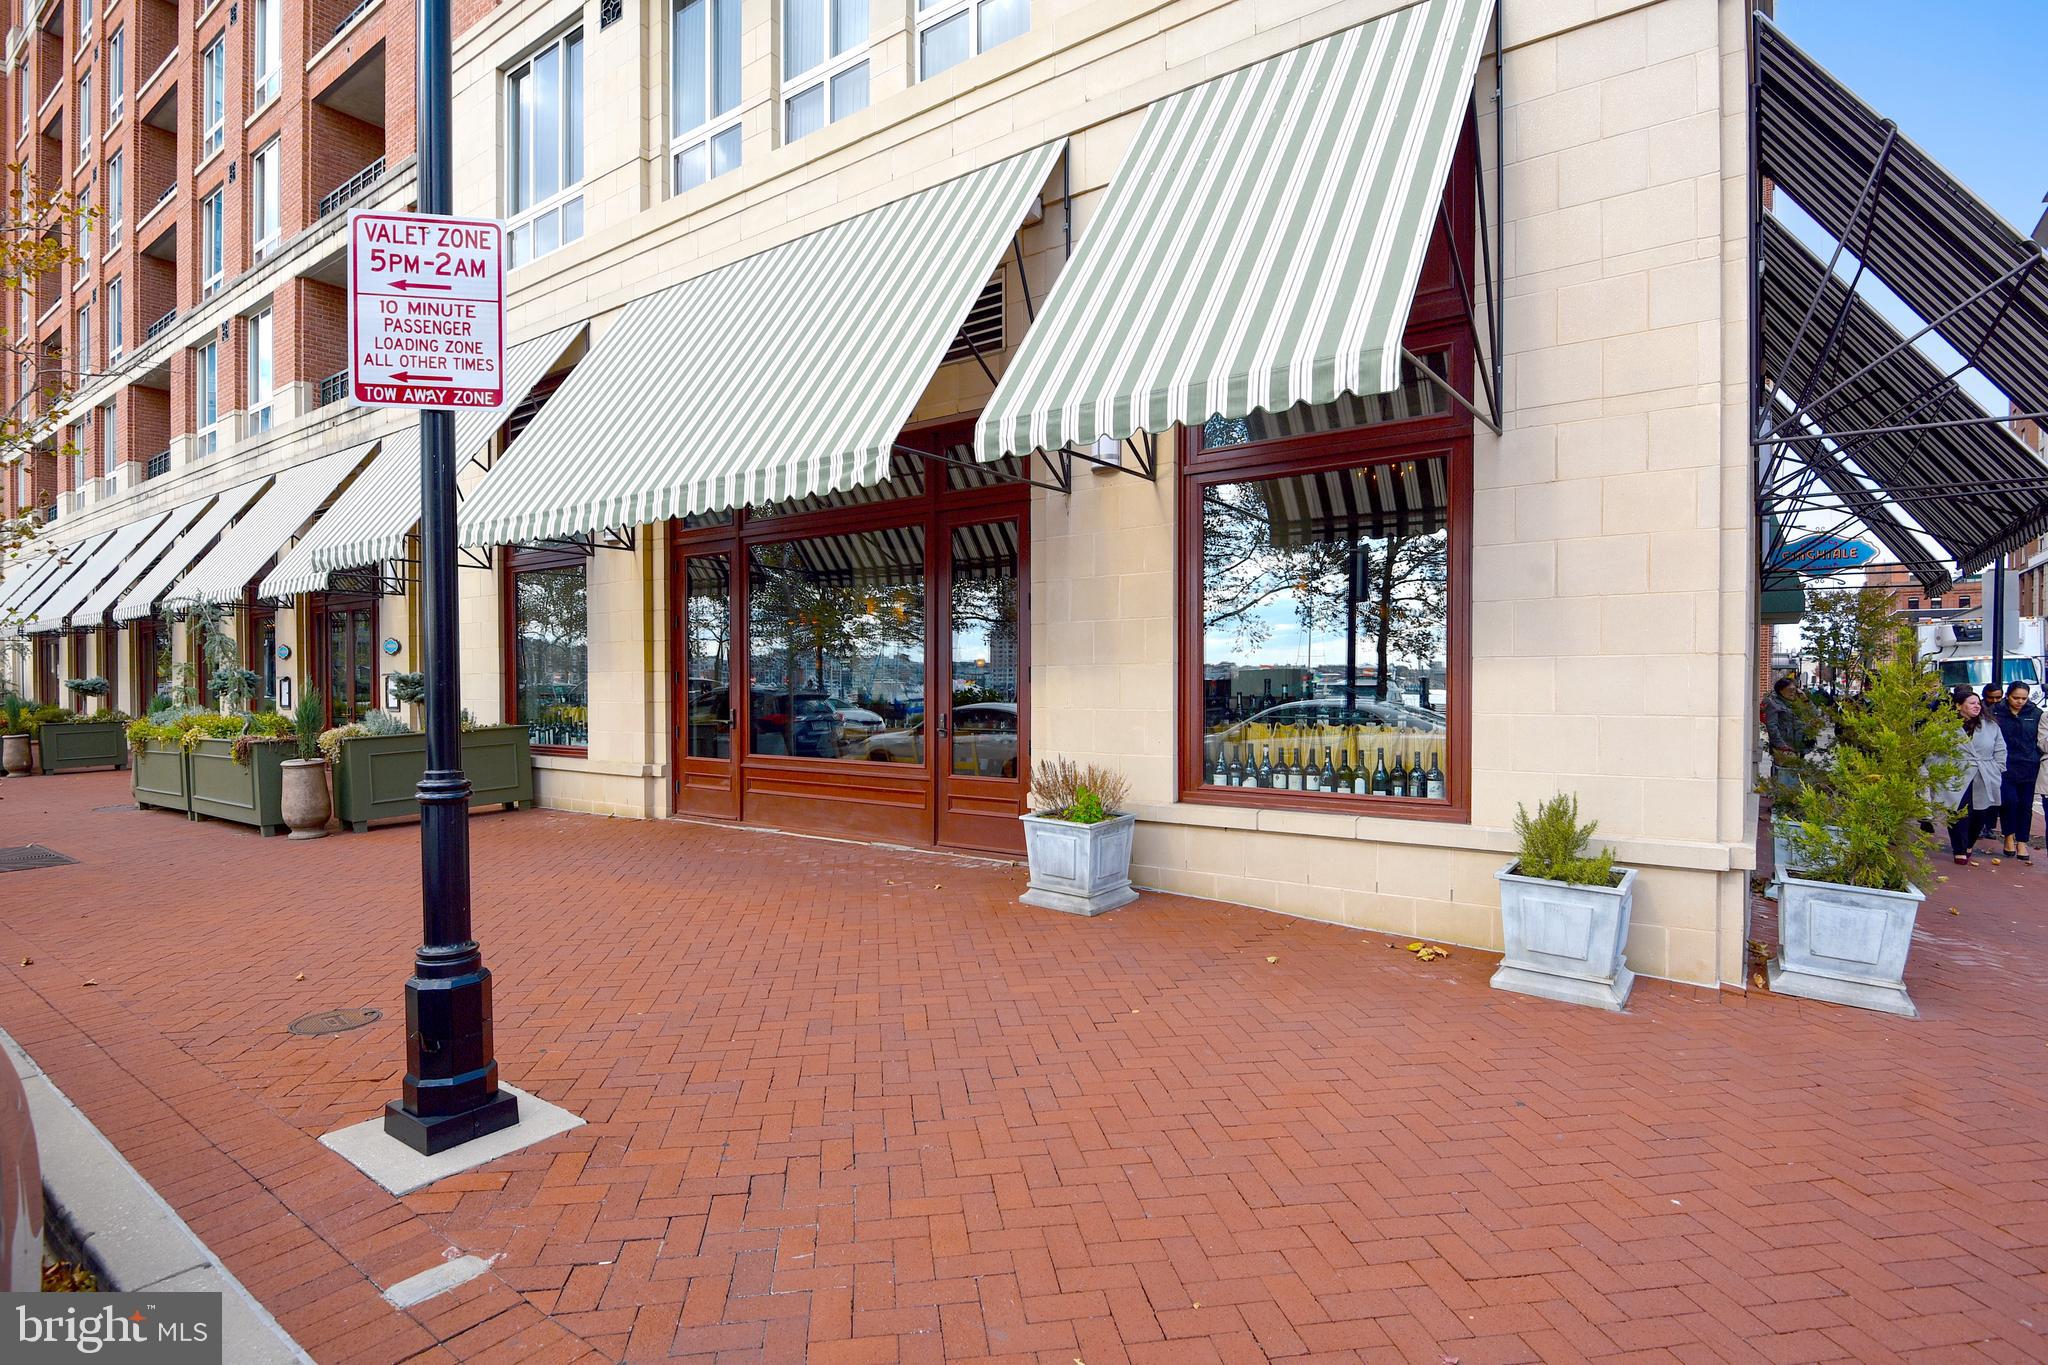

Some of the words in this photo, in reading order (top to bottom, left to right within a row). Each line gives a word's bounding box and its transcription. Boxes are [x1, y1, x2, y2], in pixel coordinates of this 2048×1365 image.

[364, 222, 430, 245] VALET
[437, 227, 492, 250] ZONE
[370, 248, 486, 279] 5PM-2AM
[379, 299, 399, 315] 10
[408, 301, 477, 319] MINUTE
[384, 317, 471, 337] PASSENGER
[374, 336, 439, 353] LOADING
[445, 340, 484, 355] ZONE
[363, 352, 394, 367] ALL
[399, 354, 447, 370] OTHER
[453, 356, 495, 372] TIMES
[364, 385, 397, 401] TOW
[402, 387, 448, 404] AWAY
[453, 390, 495, 406] ZONE
